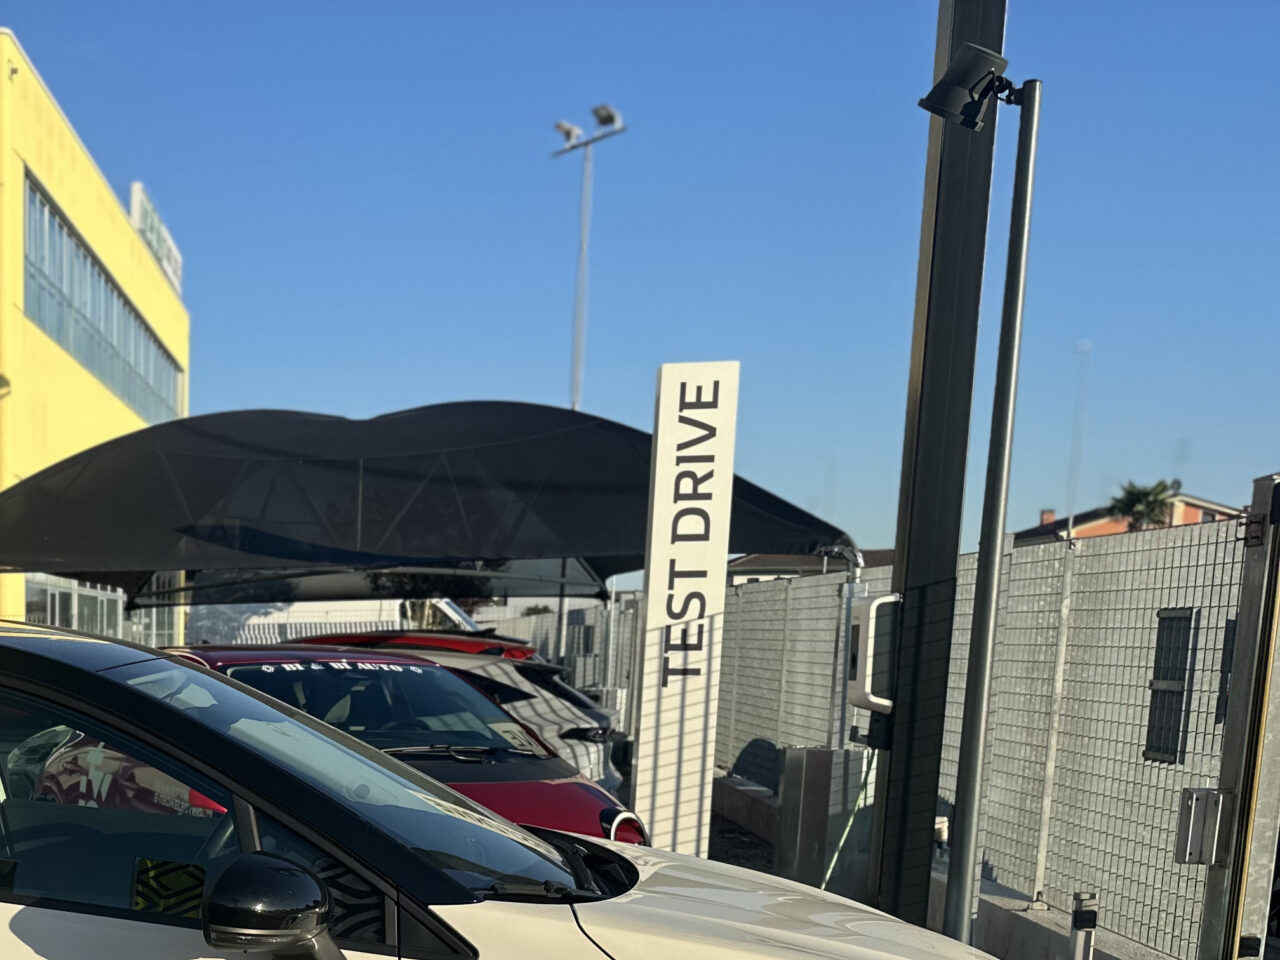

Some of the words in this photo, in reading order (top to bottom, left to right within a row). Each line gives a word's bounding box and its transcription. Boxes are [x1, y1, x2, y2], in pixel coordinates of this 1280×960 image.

[670, 380, 721, 545] DRIVE
[281, 663, 306, 671] BI
[329, 662, 353, 670] BI
[357, 663, 404, 672] AUTO
[661, 558, 708, 688] TEST
